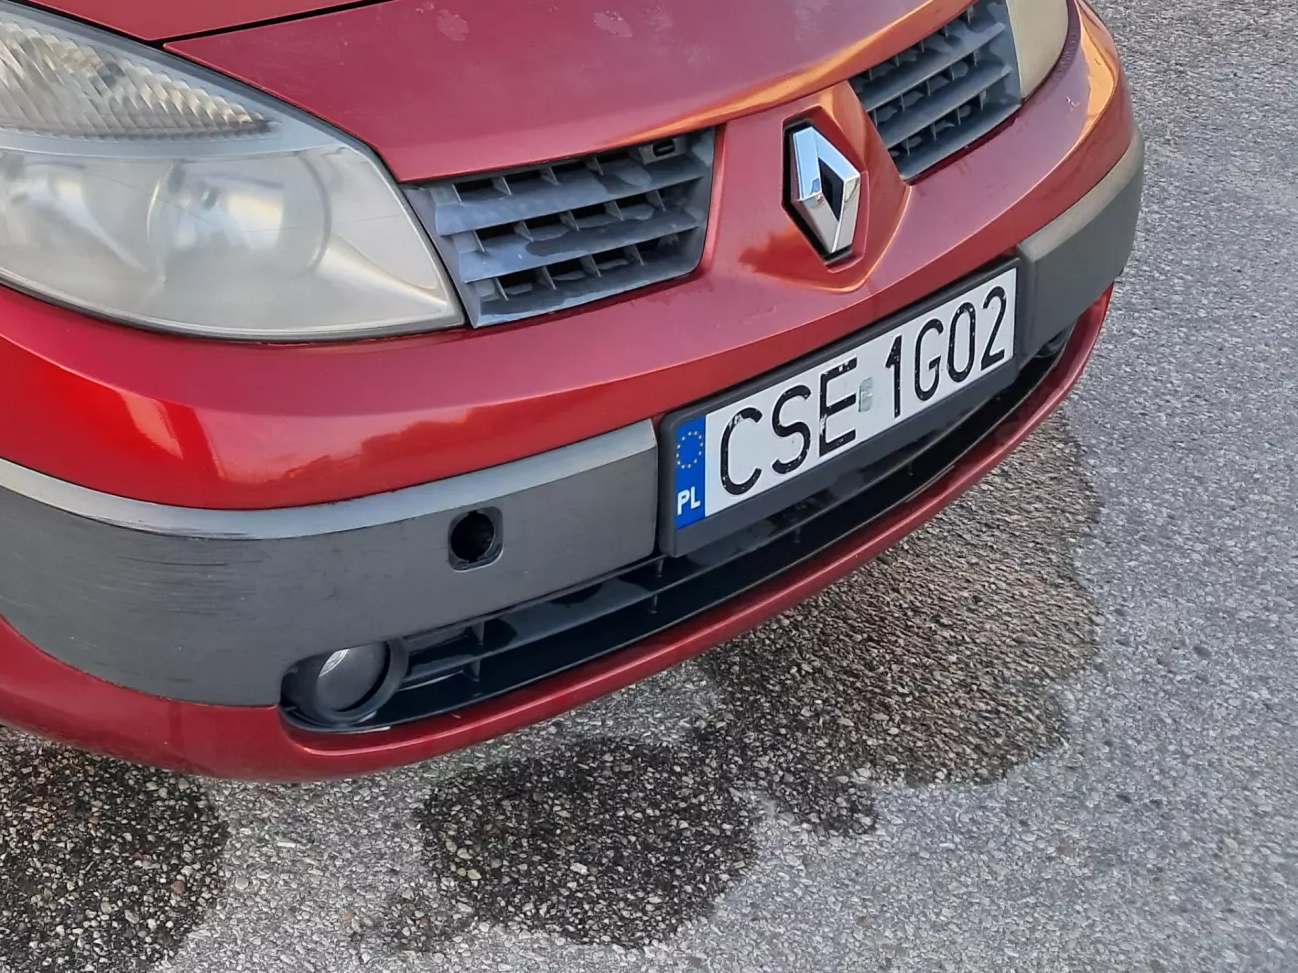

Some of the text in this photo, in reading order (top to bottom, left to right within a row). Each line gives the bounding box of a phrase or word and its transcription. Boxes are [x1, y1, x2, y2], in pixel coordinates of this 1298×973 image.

[720, 285, 1008, 495] CSE 1G02
[676, 486, 701, 515] PL
